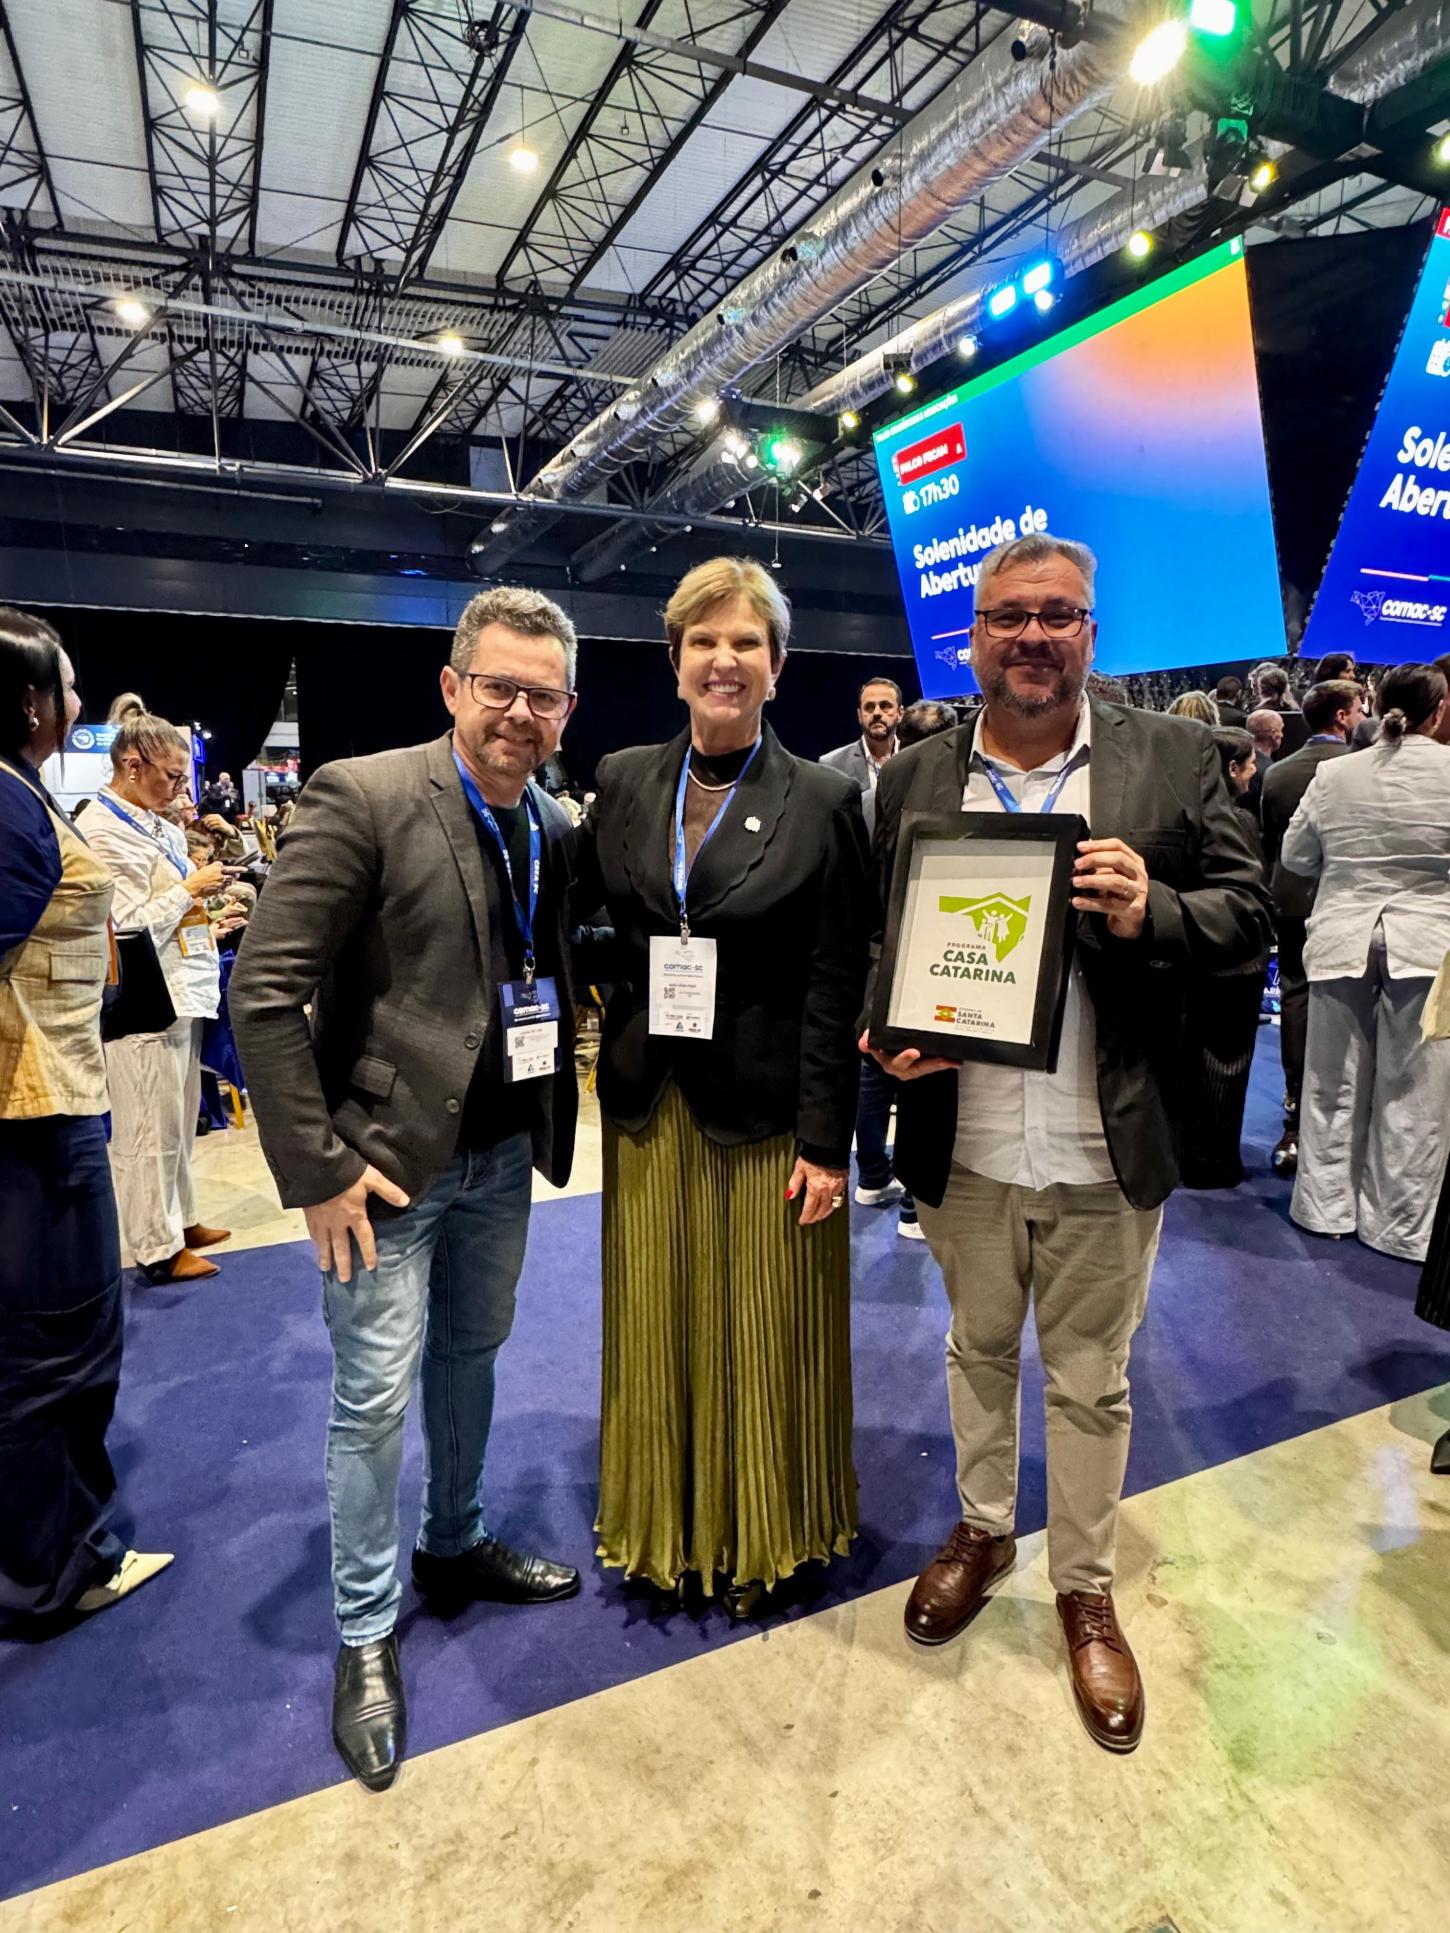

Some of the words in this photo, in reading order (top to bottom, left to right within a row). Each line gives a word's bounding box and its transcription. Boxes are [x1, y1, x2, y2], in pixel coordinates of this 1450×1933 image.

[919, 473, 960, 507] 17h30
[913, 515, 1016, 569] Solenidade
[1019, 505, 1048, 536] de
[947, 942, 986, 950] PROGRAMA
[943, 949, 988, 966] CASA
[929, 963, 1016, 984] CATARINA
[956, 1017, 995, 1028] CATARINA
[958, 1011, 982, 1020] SANTA
